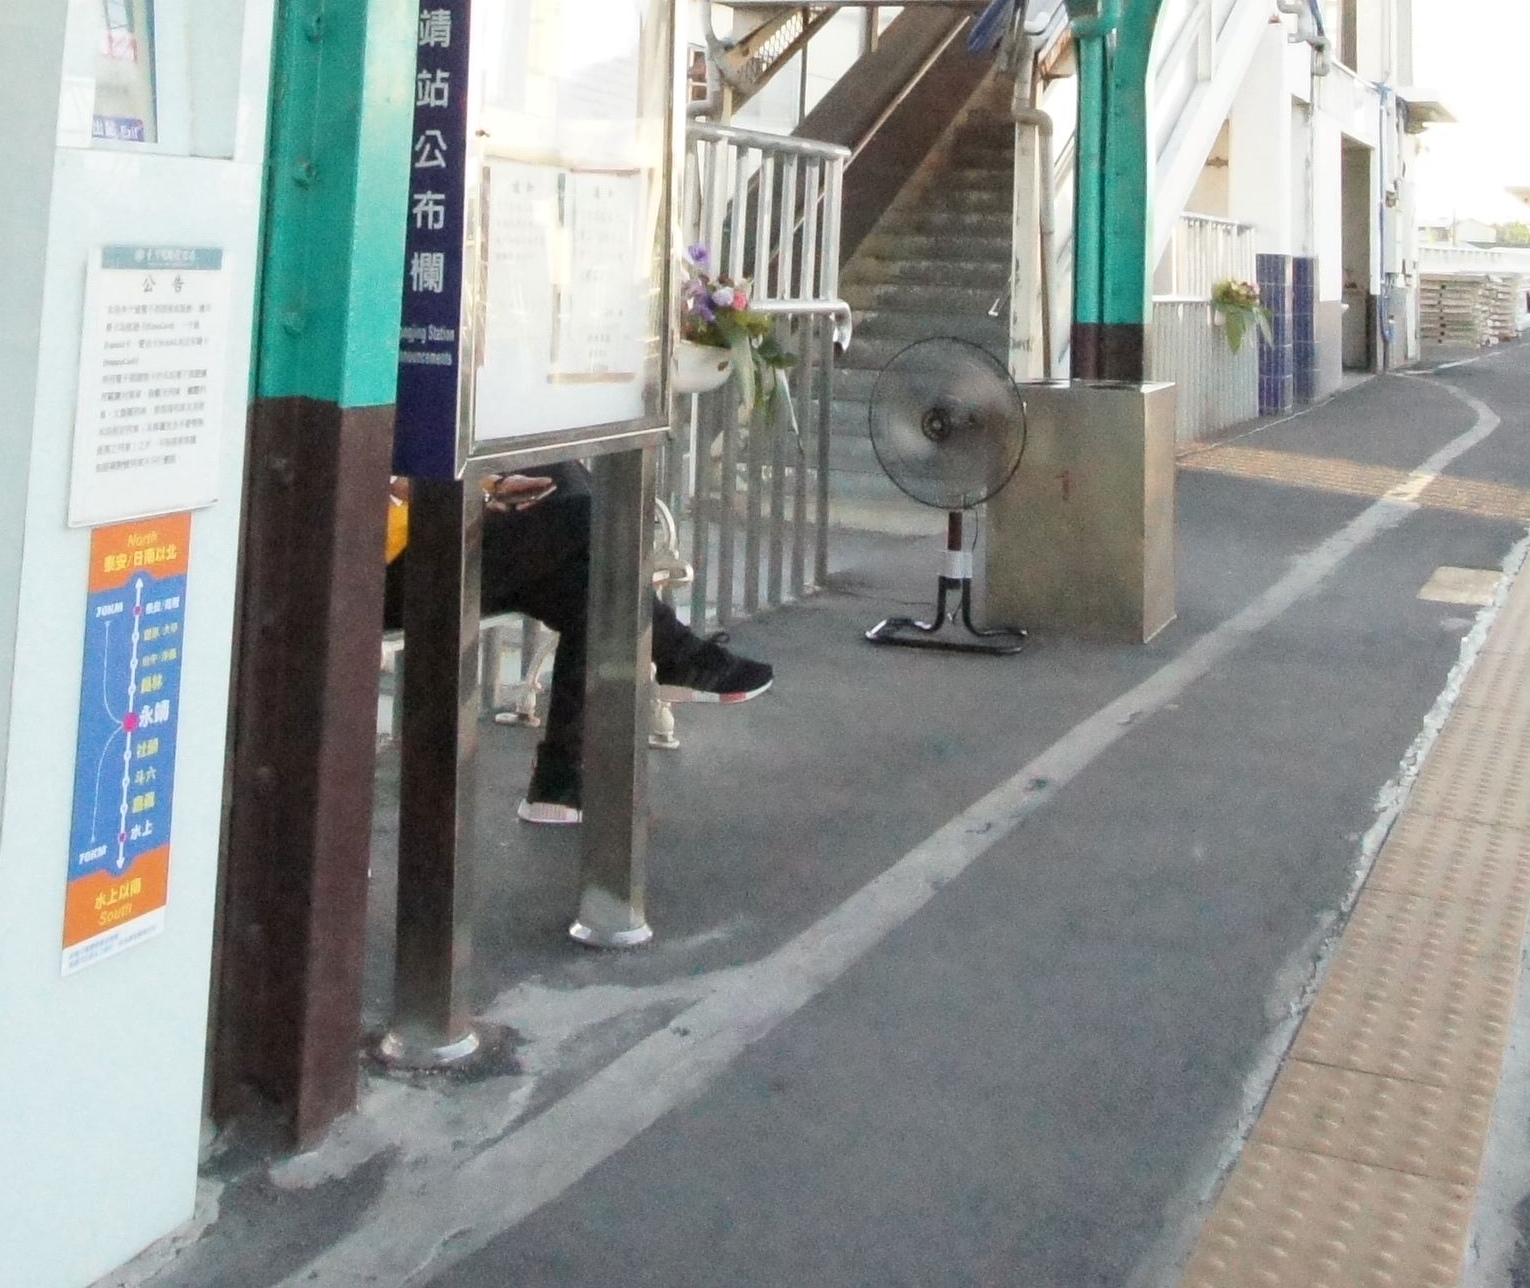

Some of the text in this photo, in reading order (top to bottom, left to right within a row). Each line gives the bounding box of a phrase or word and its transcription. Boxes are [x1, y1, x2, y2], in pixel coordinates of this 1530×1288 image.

[142, 273, 185, 294] 公告
[127, 530, 158, 547] North
[99, 903, 133, 926] South
